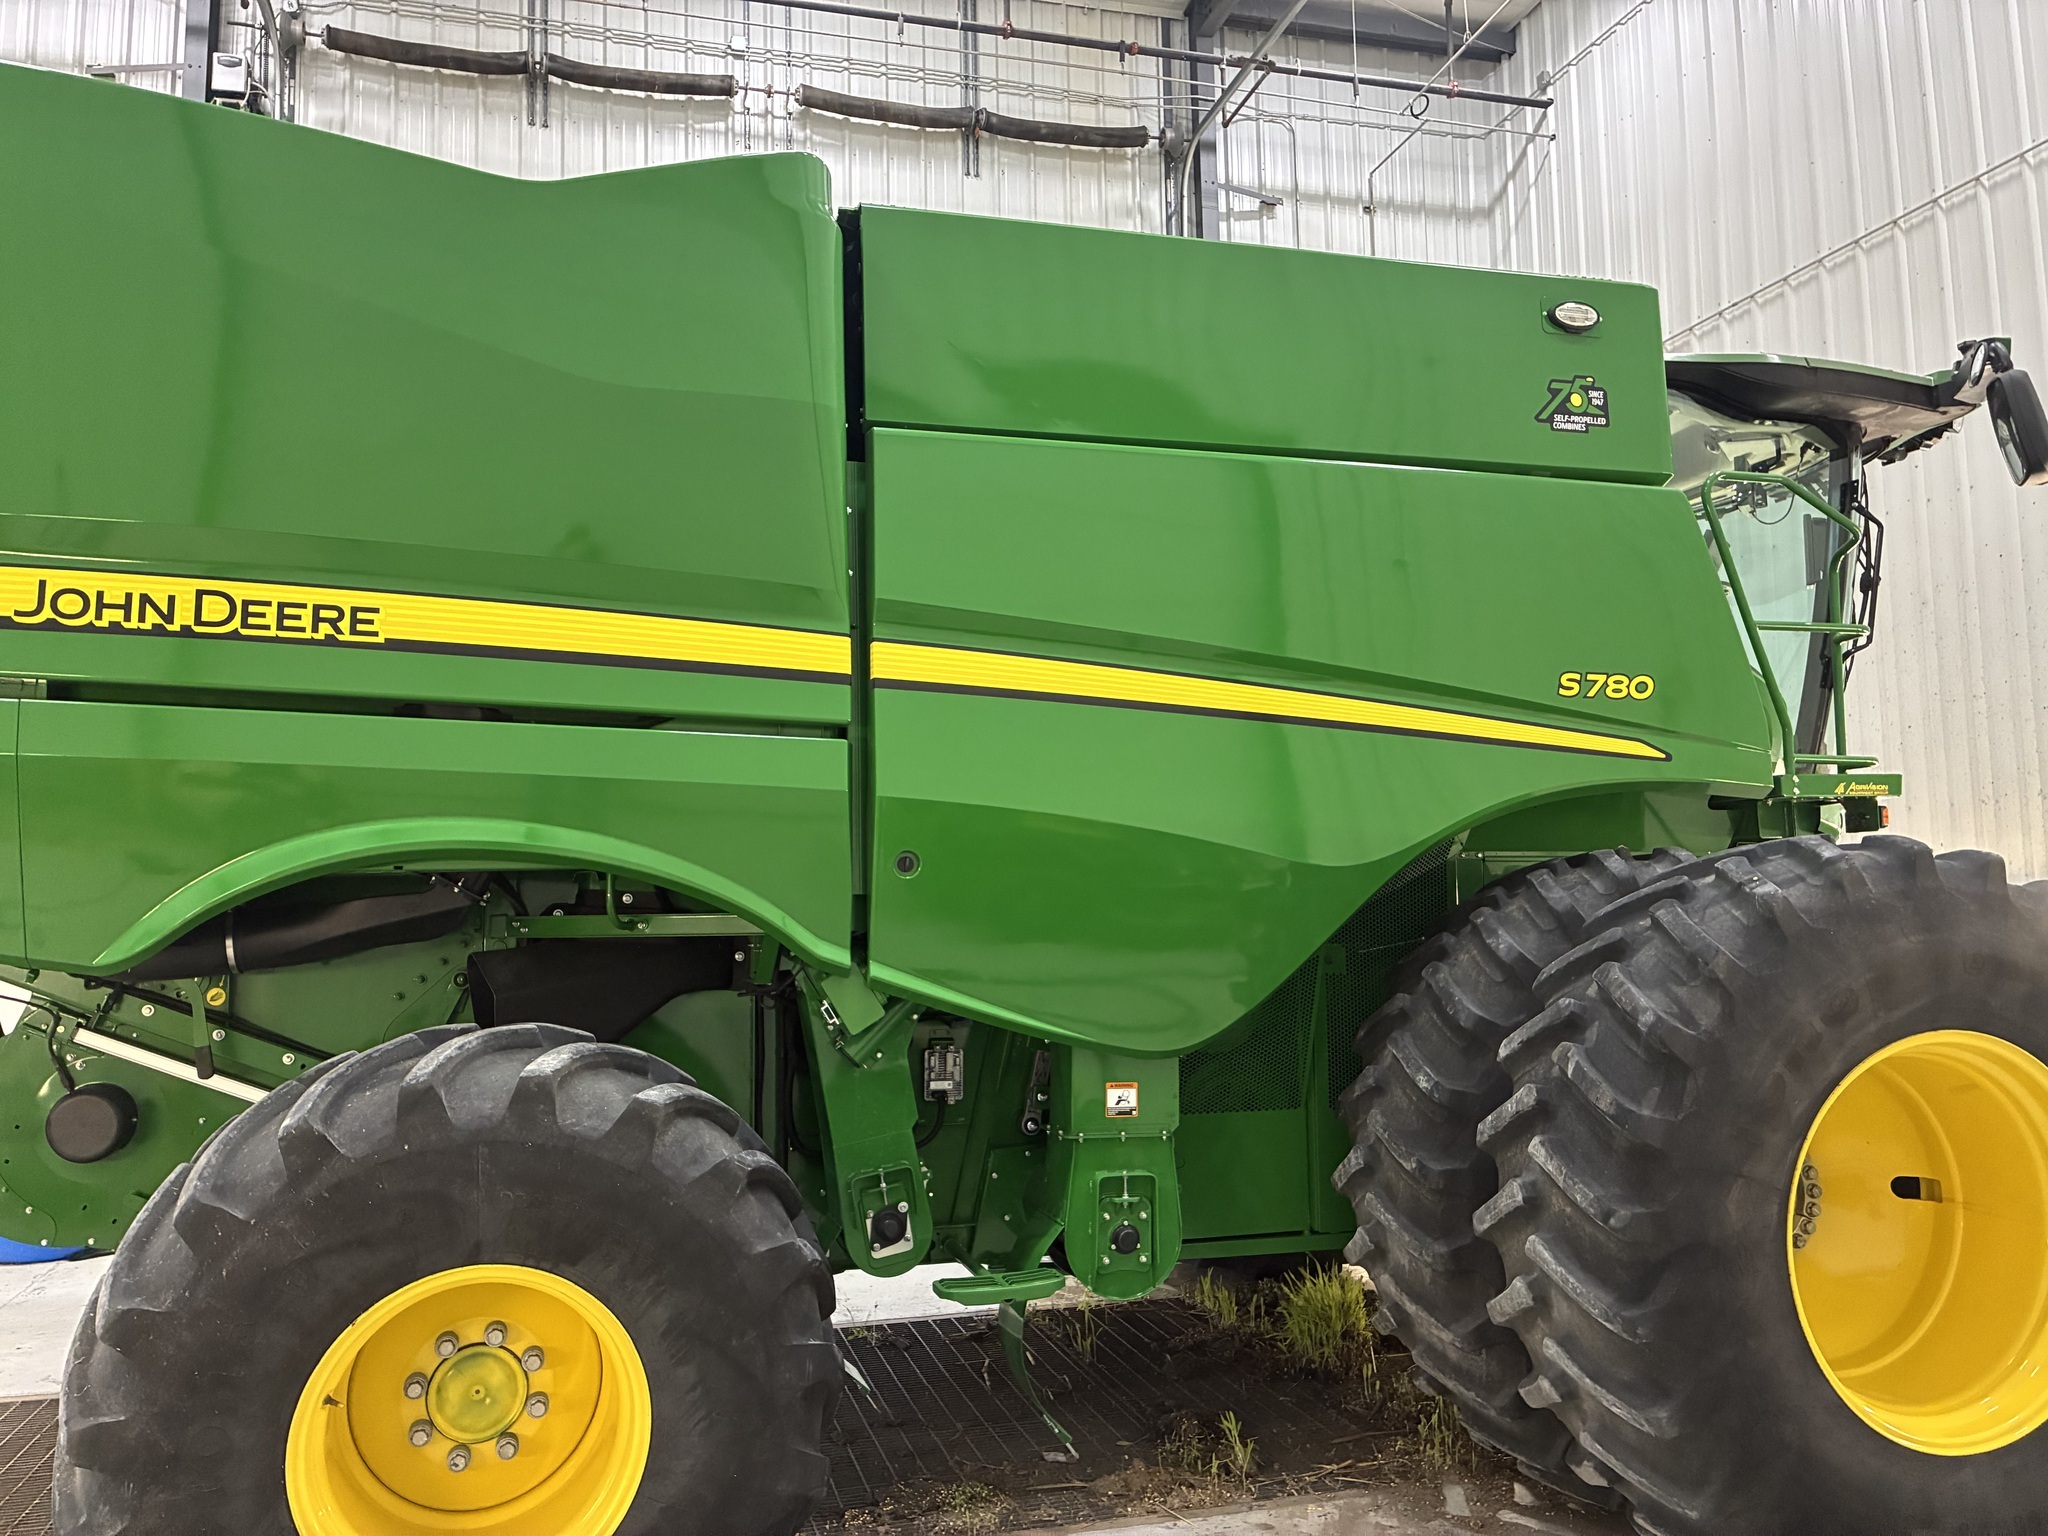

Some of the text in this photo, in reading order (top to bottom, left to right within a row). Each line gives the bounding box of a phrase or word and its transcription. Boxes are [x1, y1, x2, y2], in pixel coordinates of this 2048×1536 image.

[1538, 377, 1593, 420] 75
[1588, 390, 1604, 399] SINCE
[1591, 398, 1605, 406] 1947
[1553, 414, 1607, 425] SELF-PROPELLED
[1552, 421, 1586, 432] COMBINES
[13, 579, 381, 638] JOHN DEERE
[1557, 670, 1656, 701] S780
